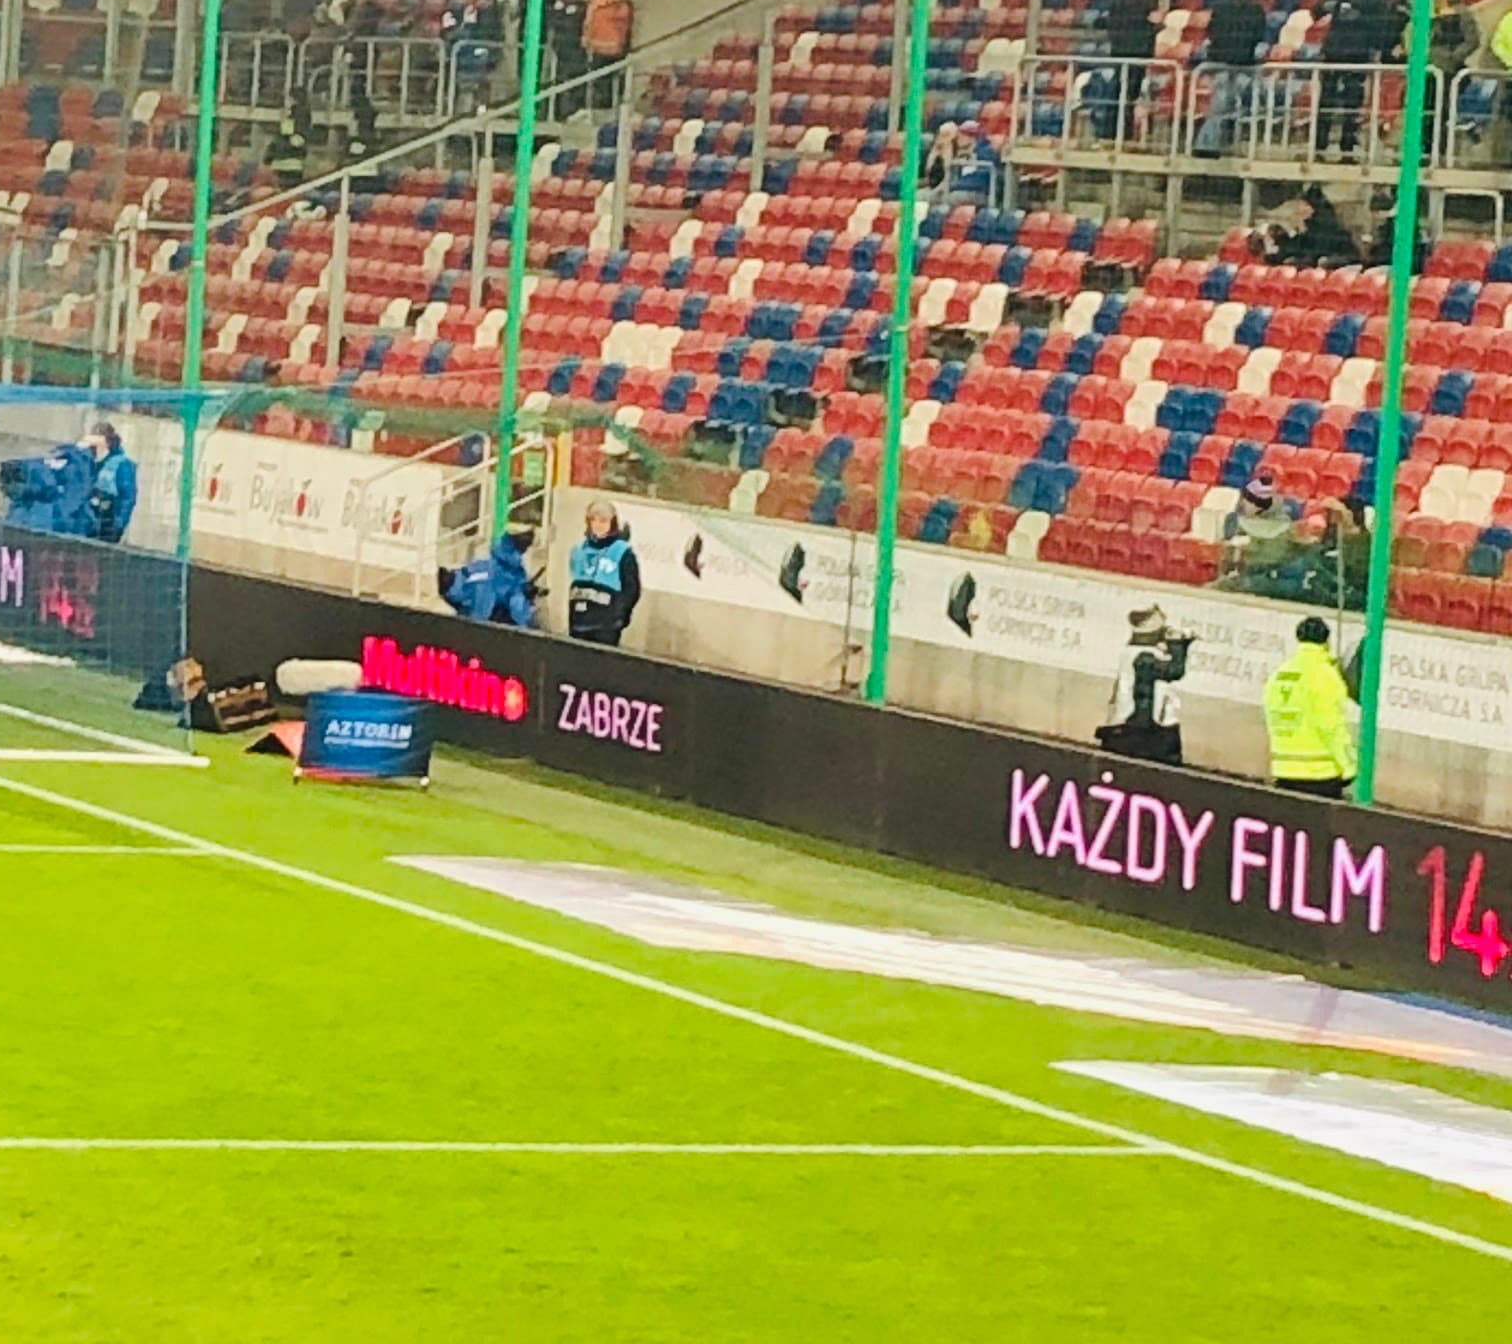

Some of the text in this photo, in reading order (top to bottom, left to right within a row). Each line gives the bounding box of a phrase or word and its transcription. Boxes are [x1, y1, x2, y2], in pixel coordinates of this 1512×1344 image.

[326, 719, 413, 741] AZTORIN
[557, 684, 664, 753] ZABRZE
[1009, 768, 1214, 891] KAŻDY
[1230, 816, 1386, 934] FILM
